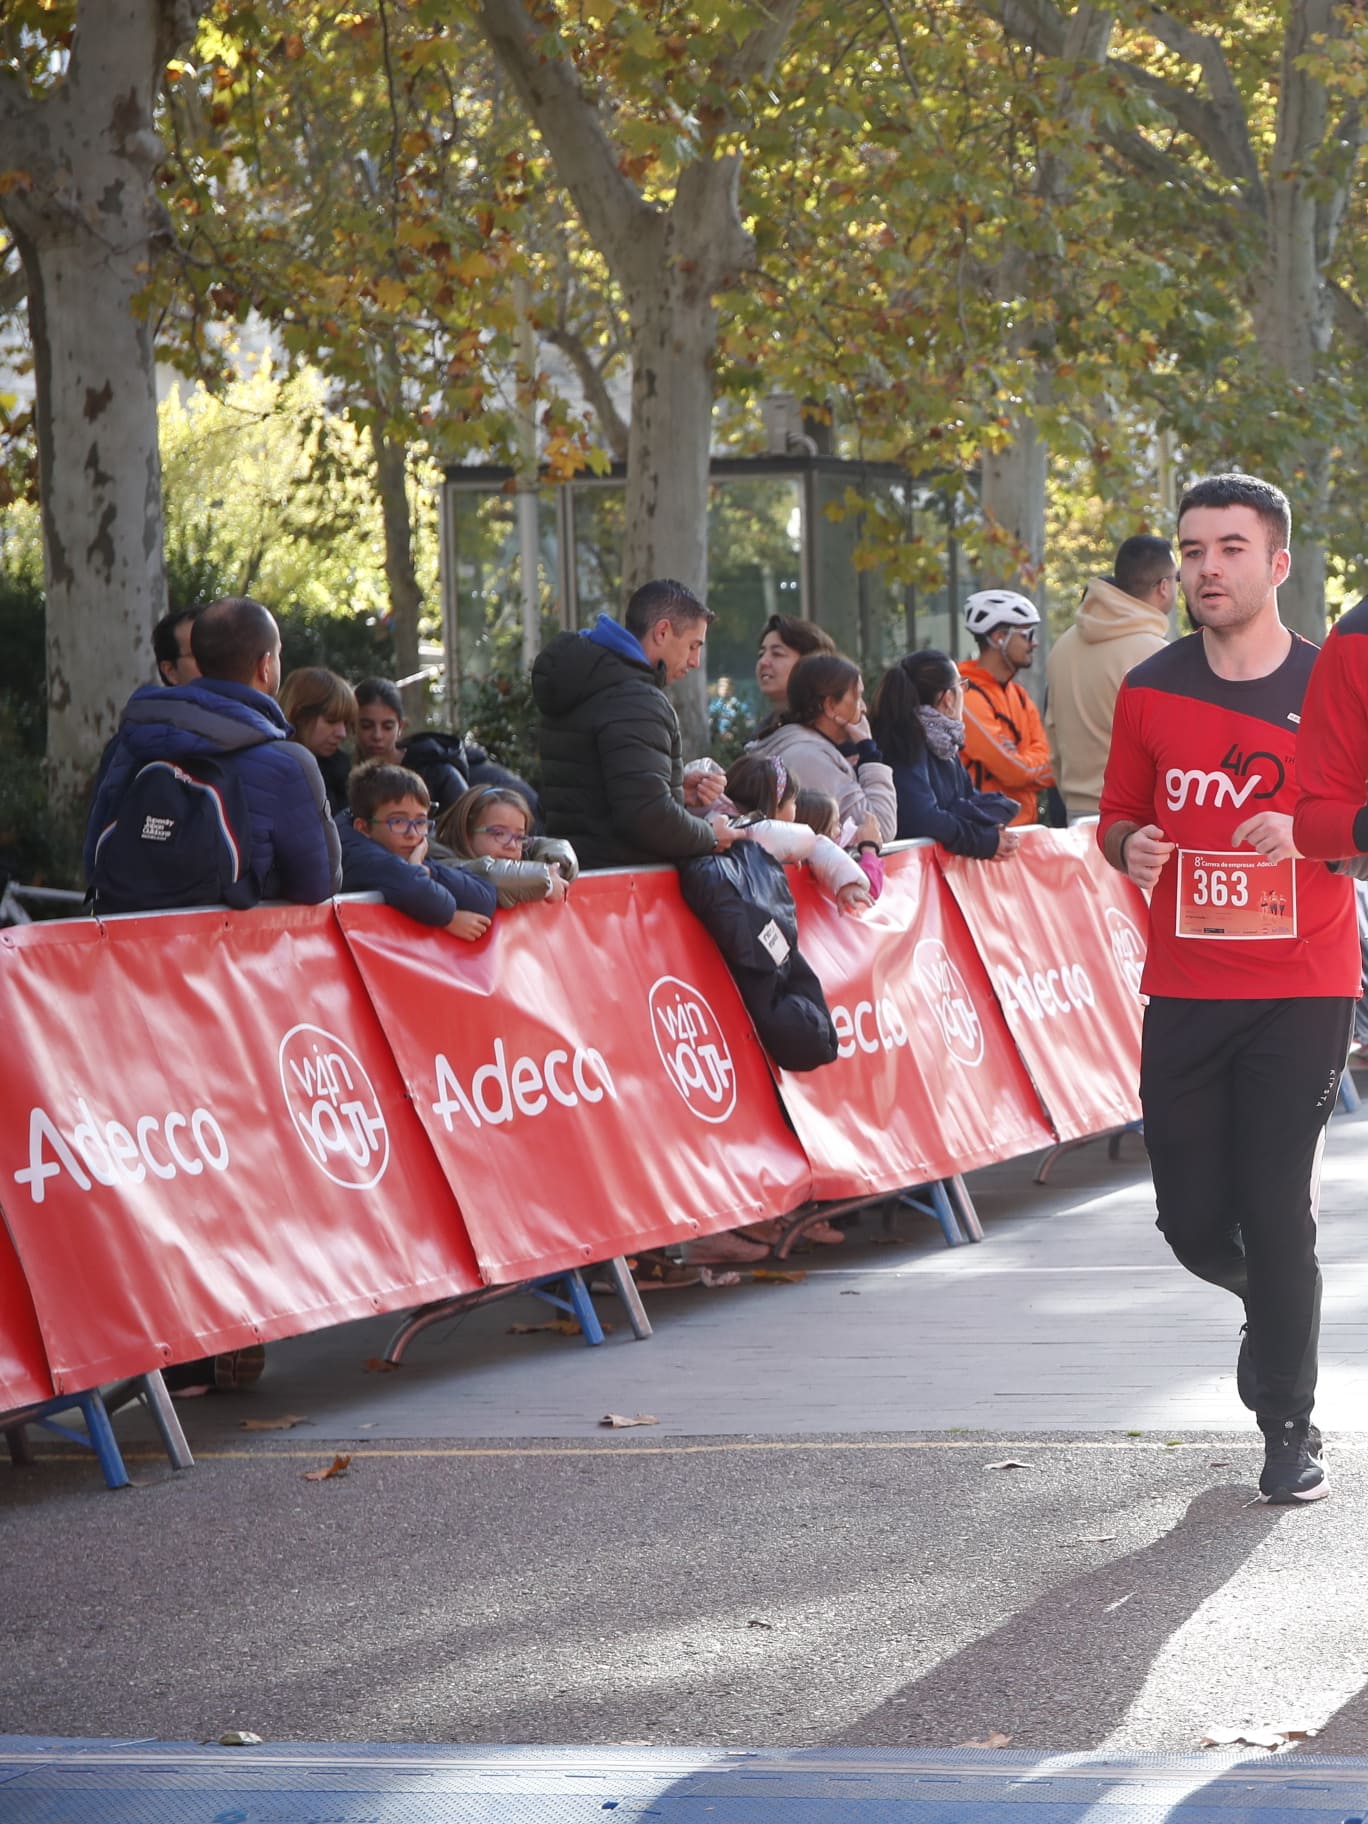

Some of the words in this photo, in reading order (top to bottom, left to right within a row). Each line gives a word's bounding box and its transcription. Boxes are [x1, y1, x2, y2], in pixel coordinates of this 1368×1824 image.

[1166, 768, 1262, 812] gmv
[1193, 869, 1249, 906] 363
[831, 984, 908, 1059] ecco
[997, 957, 1095, 1024] Adecco
[432, 1037, 618, 1132] Adecco
[14, 1097, 229, 1204] Adecco
